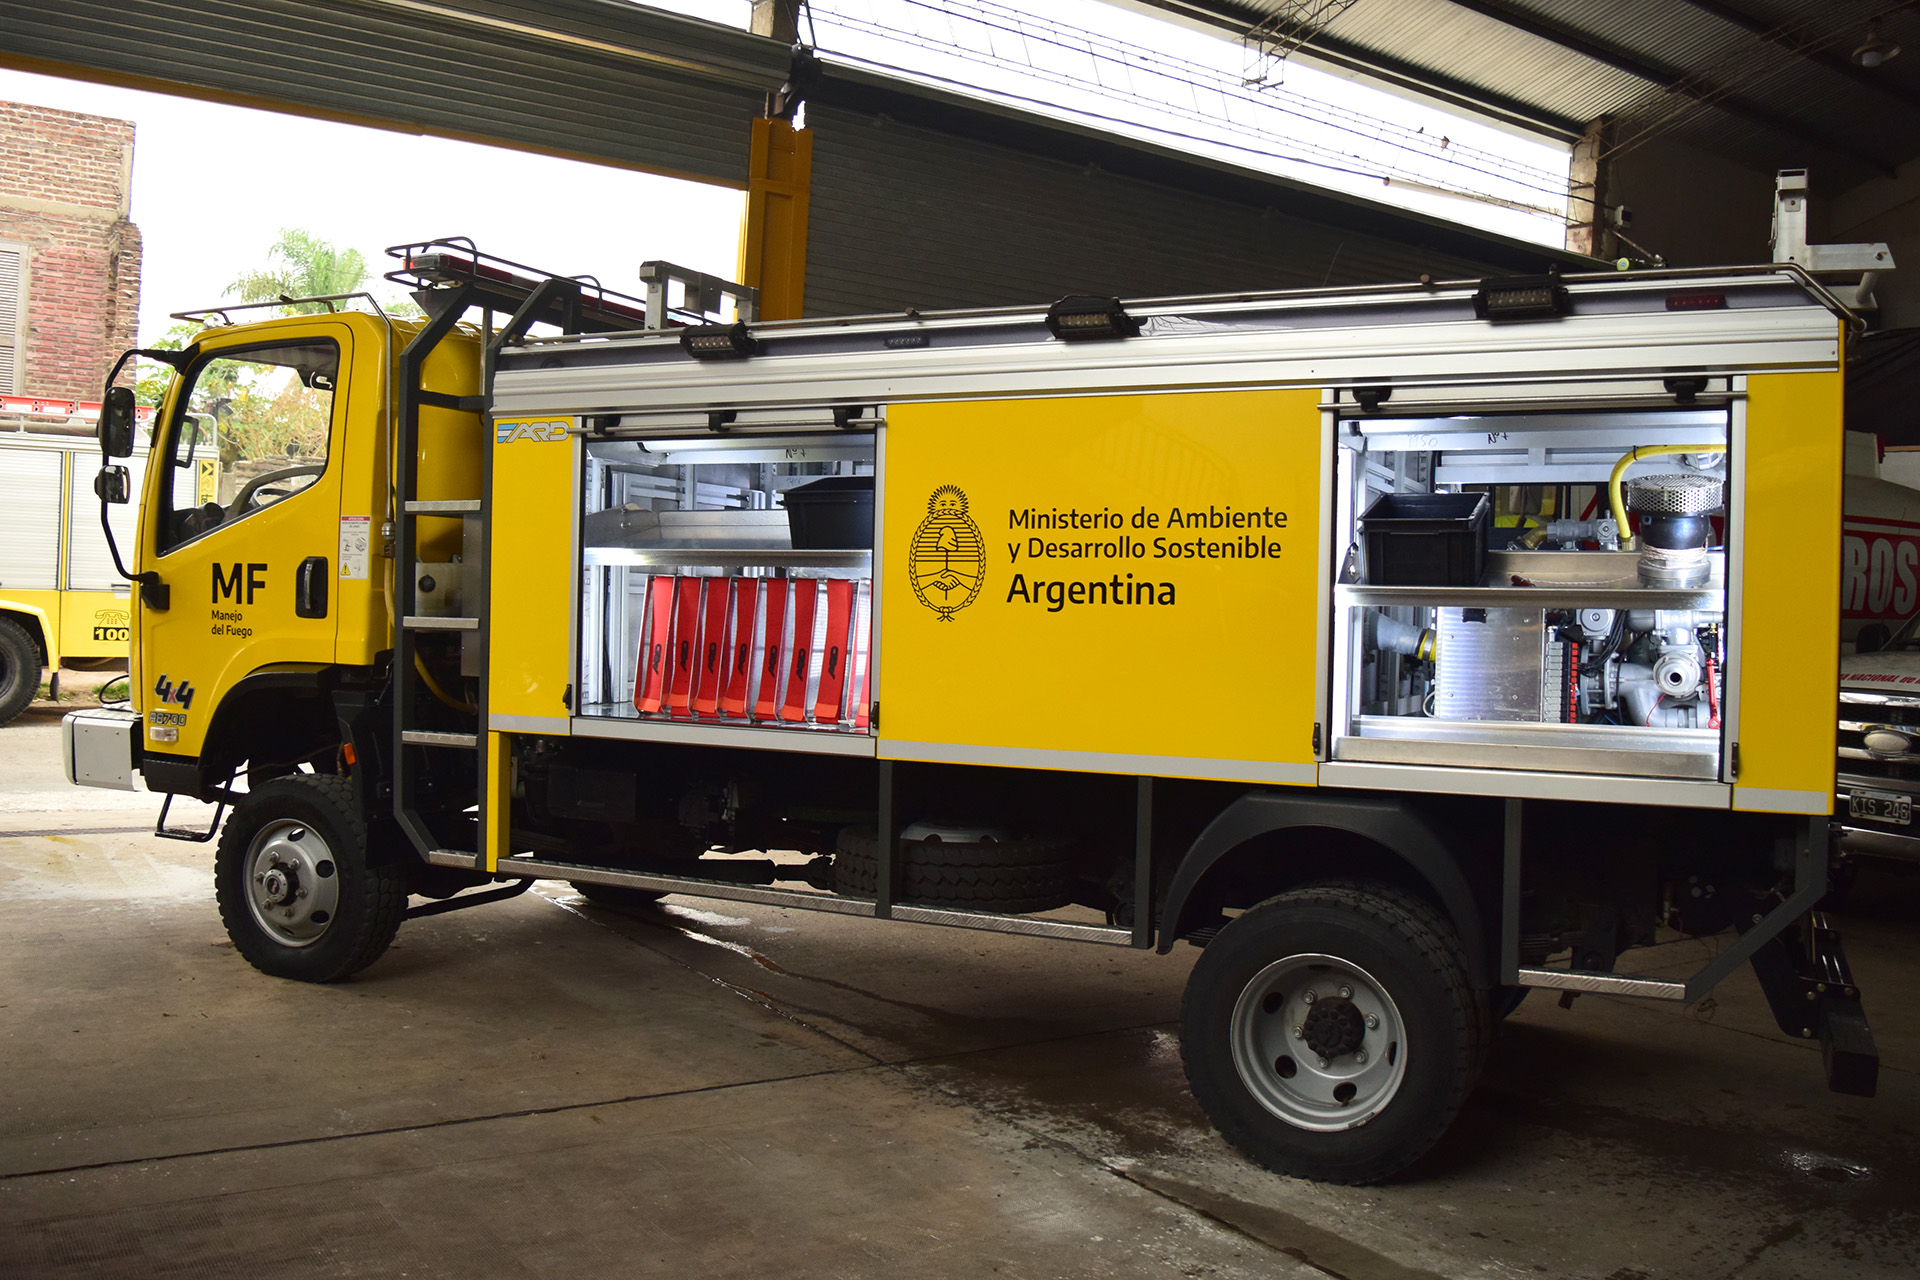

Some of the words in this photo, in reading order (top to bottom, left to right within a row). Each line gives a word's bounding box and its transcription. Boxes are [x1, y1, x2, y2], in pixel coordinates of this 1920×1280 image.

[1009, 507, 1124, 530] Ministerio
[1131, 506, 1160, 529] de
[1166, 505, 1288, 529] Ambiente
[1008, 541, 1021, 563] y
[1028, 536, 1146, 558] Desarrollo
[1153, 535, 1281, 559] Sostenible
[212, 562, 268, 605] MF
[1006, 572, 1176, 613] Argentina
[211, 609, 243, 623] Manejo
[95, 628, 129, 641] 100
[211, 623, 224, 635] del
[226, 624, 253, 639] Fuego
[1848, 674, 1899, 682] NACIONAL
[154, 674, 195, 710] 4x4
[1851, 798, 1876, 815] KIS
